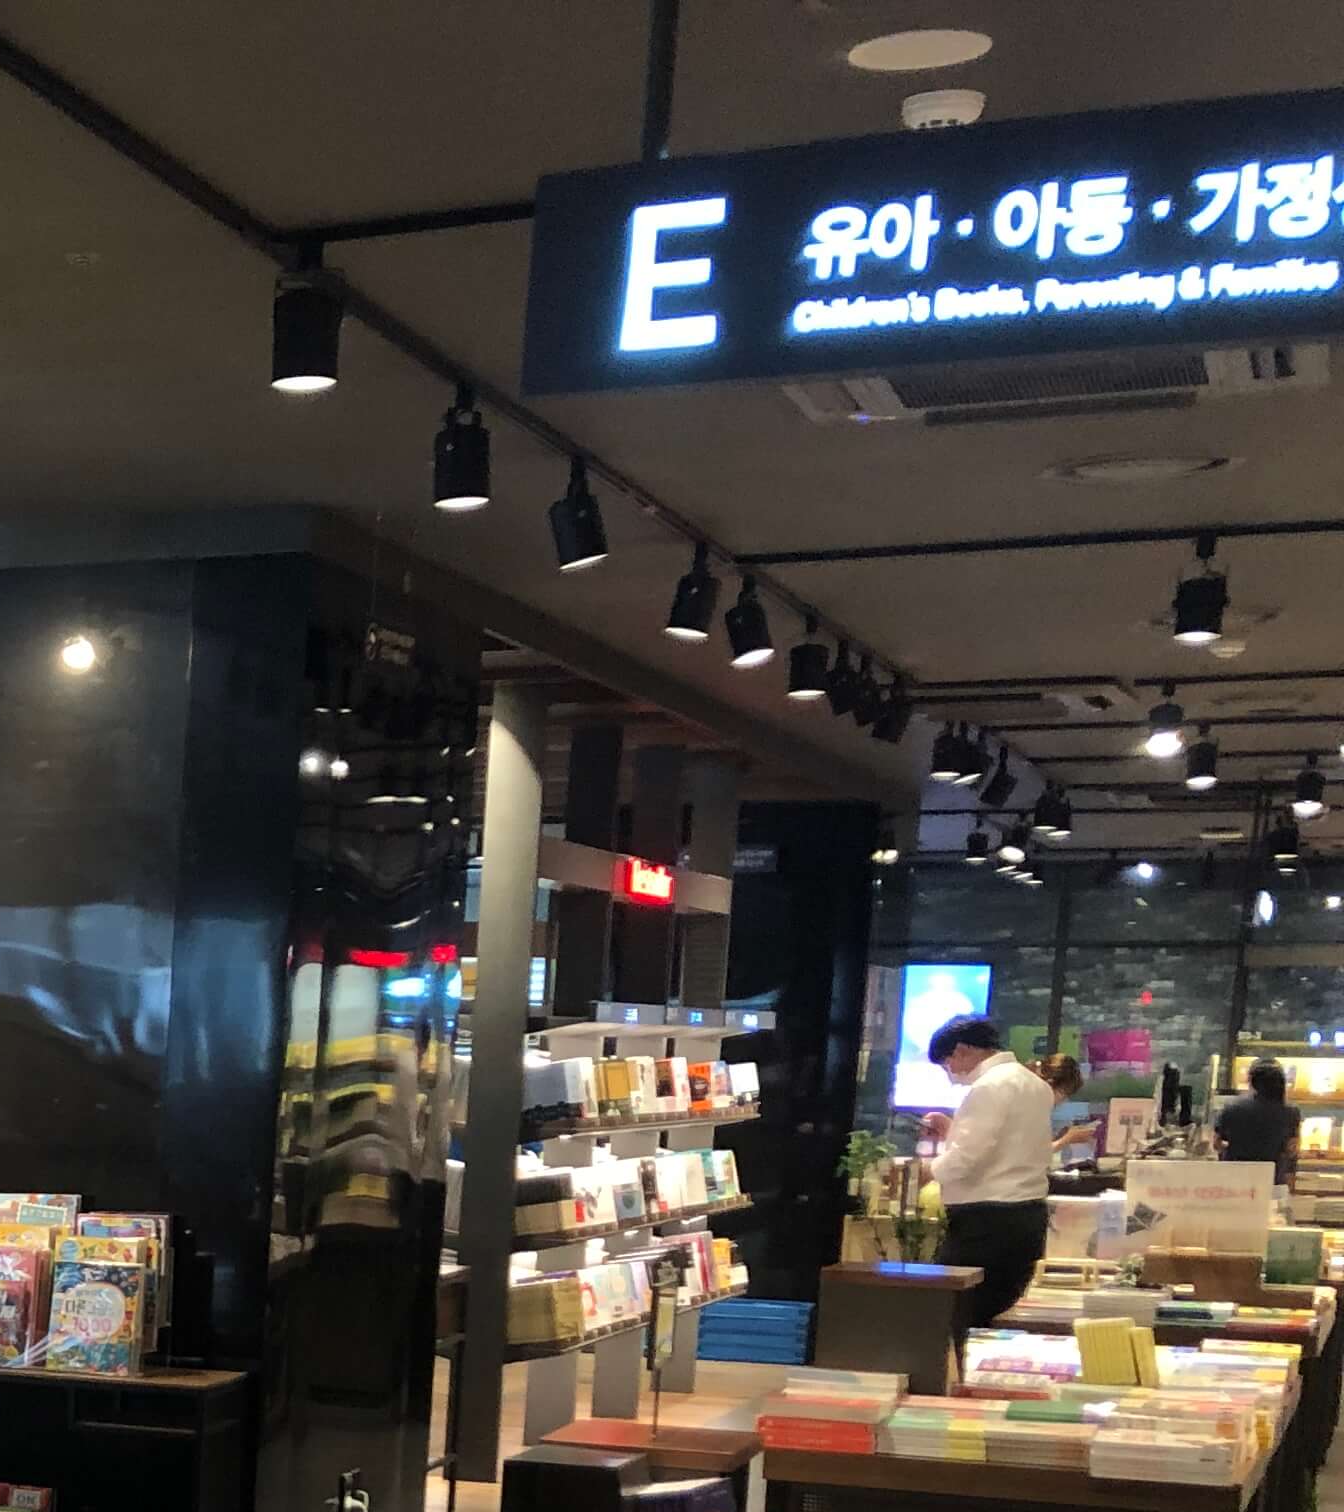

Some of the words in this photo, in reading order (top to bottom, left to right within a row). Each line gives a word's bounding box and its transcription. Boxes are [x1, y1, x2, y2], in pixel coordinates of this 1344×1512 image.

[618, 197, 728, 353] E
[802, 194, 940, 281] 유아
[994, 175, 1133, 261] 아동
[1187, 154, 1344, 245] 가정
[1178, 264, 1206, 299] &
